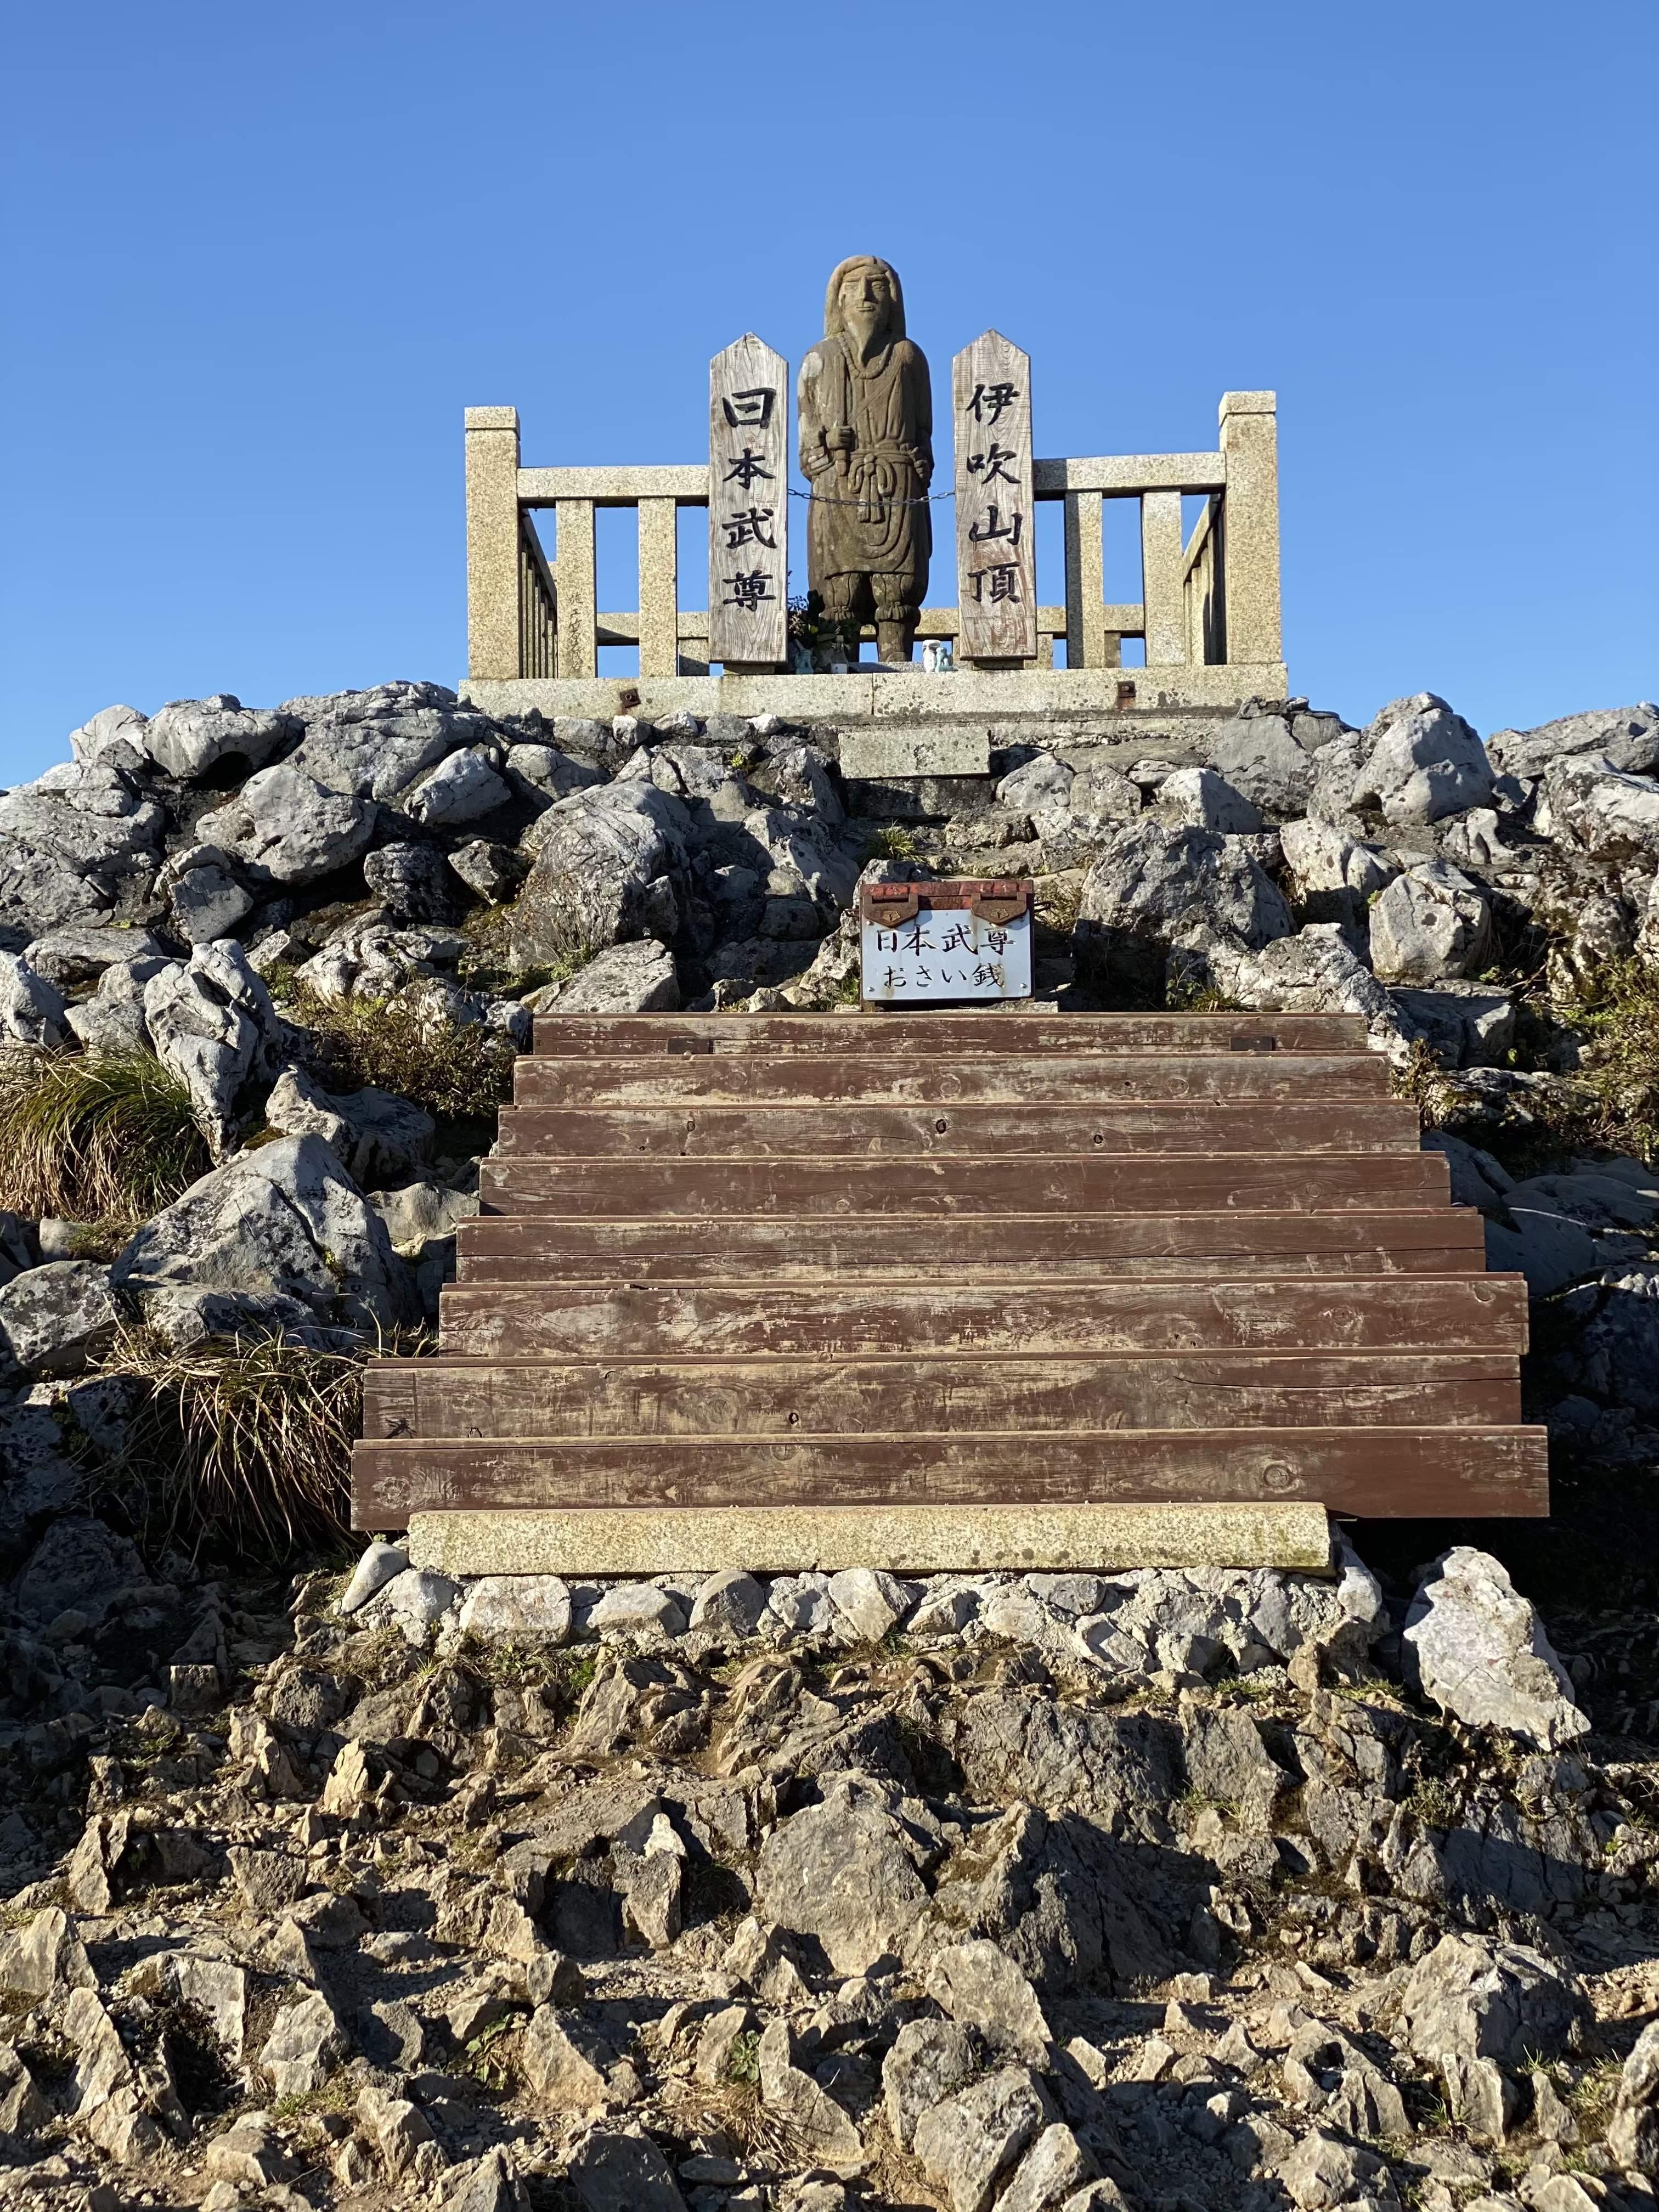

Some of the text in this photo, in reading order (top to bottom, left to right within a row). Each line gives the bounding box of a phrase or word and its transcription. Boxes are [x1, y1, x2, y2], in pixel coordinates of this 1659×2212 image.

[722, 387, 777, 612] 日本武尊
[966, 382, 1022, 603] 伊吹山頂
[877, 924, 1017, 956] 日本武尊
[883, 963, 1005, 988] おさい銭
